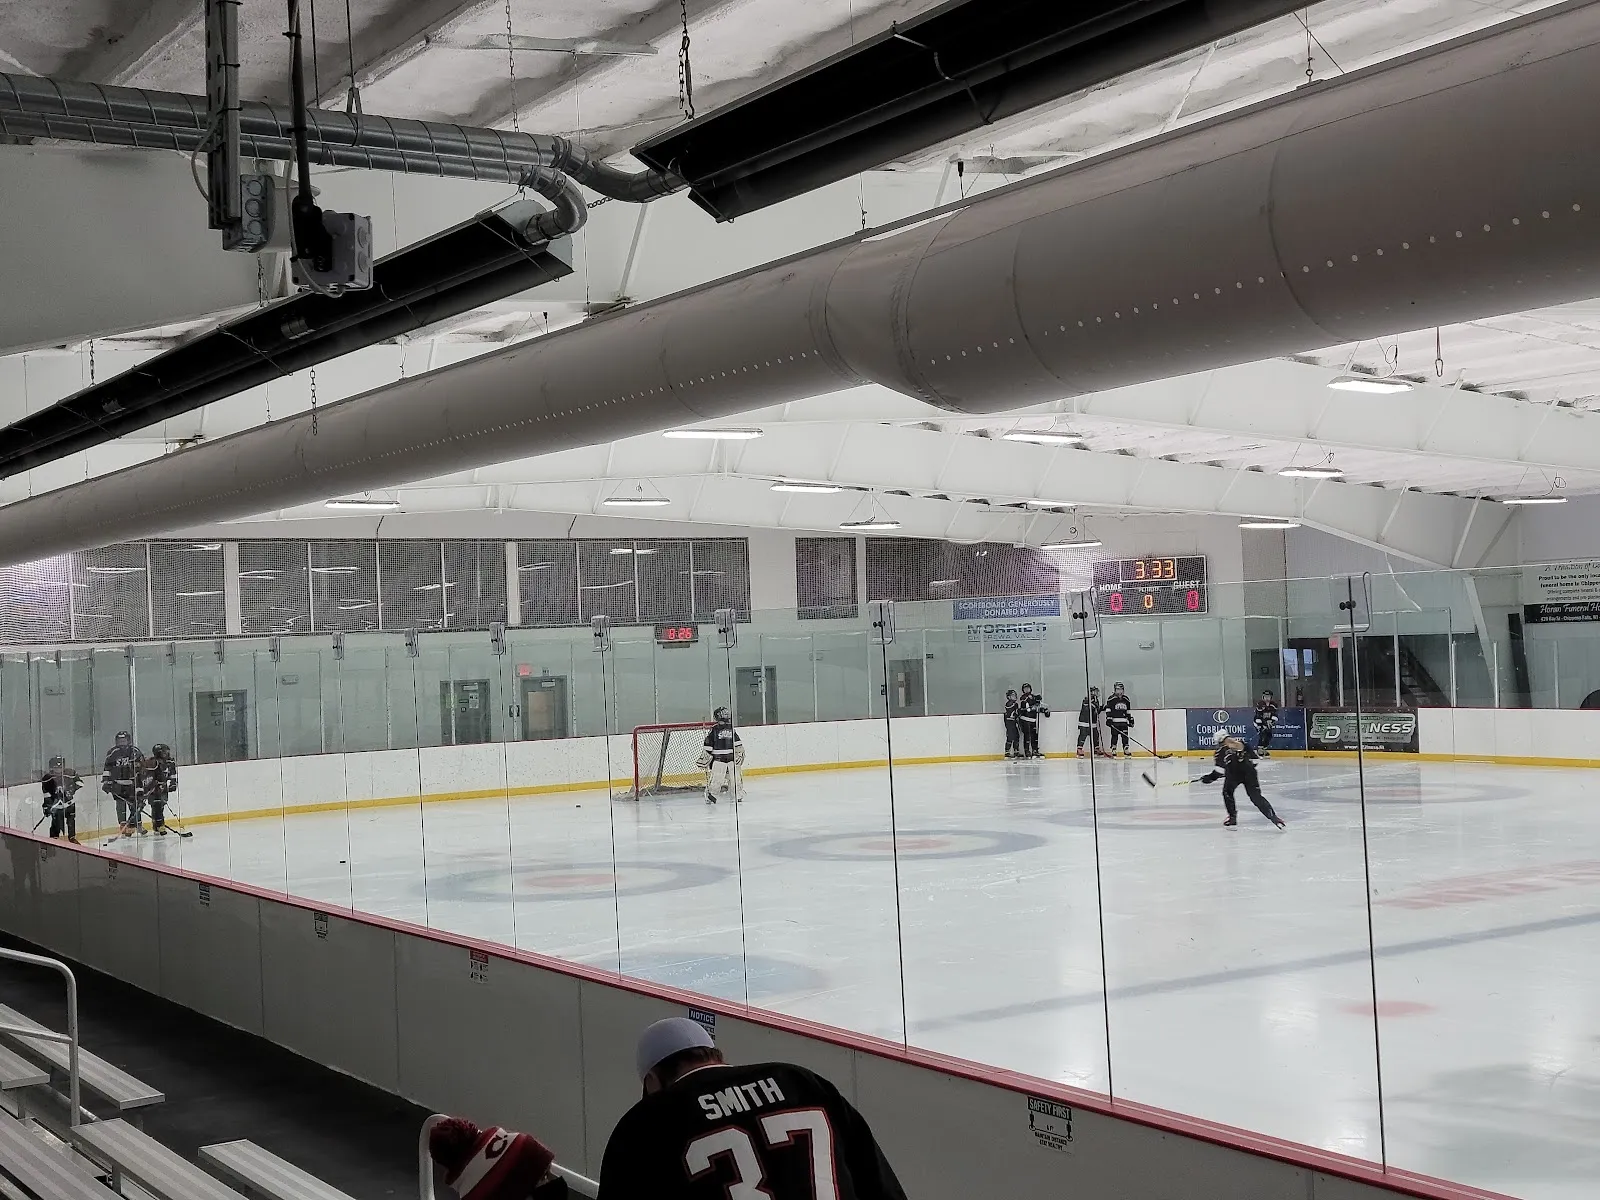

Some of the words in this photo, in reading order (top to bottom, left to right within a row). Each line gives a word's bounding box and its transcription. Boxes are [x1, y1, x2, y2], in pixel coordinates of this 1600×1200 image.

[1135, 560, 1174, 579] 3:33
[1099, 583, 1122, 591] HOME
[1173, 580, 1200, 589] GUEST
[959, 601, 1006, 609] SCOREBOARD
[1008, 599, 1056, 608] GENEROUSLY
[1144, 594, 1153, 609] 0
[1187, 590, 1199, 609] 0
[1563, 602, 1589, 612] Funeral
[1344, 722, 1413, 734] FTNESS
[690, 1010, 715, 1024] NOTICE
[698, 1077, 785, 1121] SMITH
[1029, 1098, 1052, 1115] SAFETY
[1052, 1104, 1070, 1120] FIRST
[682, 1107, 842, 1200] 37
